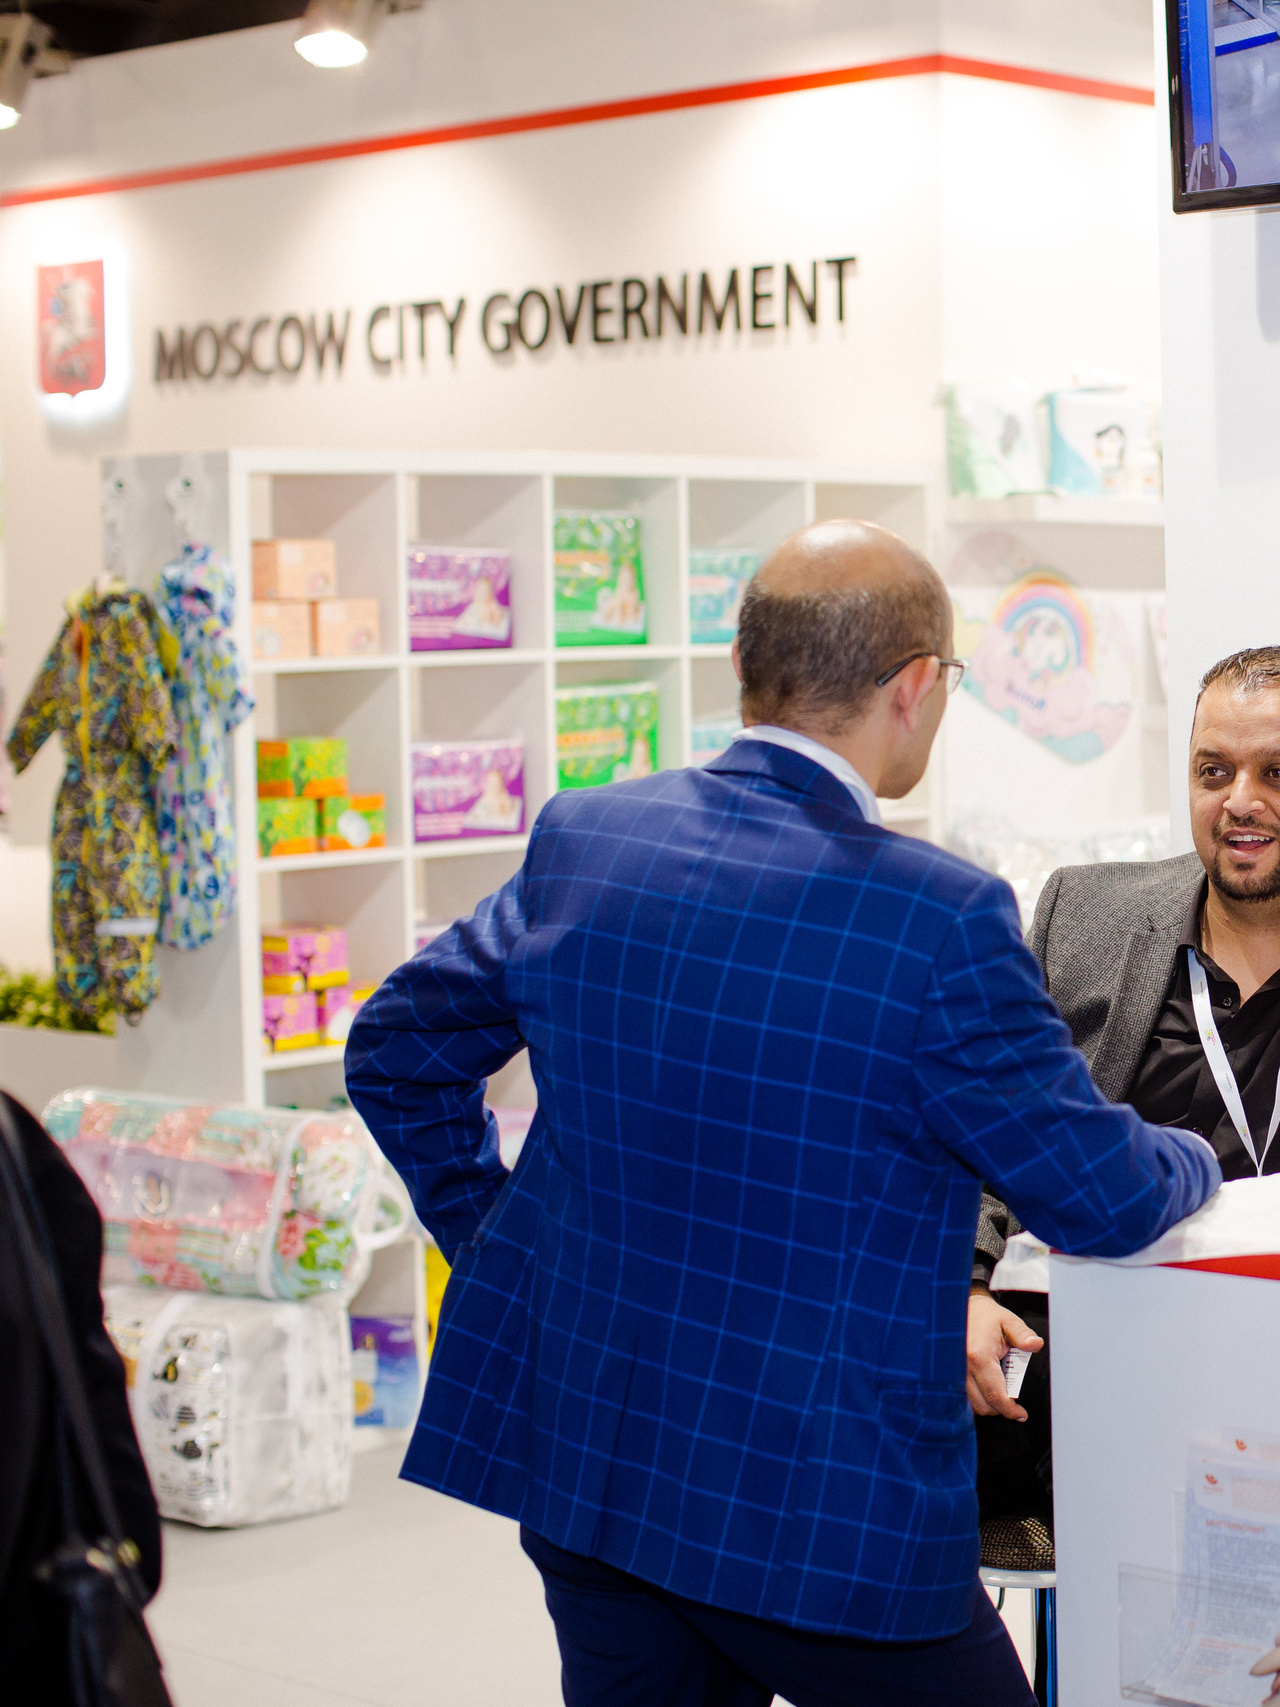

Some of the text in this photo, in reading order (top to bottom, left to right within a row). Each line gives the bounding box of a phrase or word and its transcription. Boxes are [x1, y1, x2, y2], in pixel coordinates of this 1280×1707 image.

[154, 256, 857, 382] MOSCOW CITY GOVERNMENT
